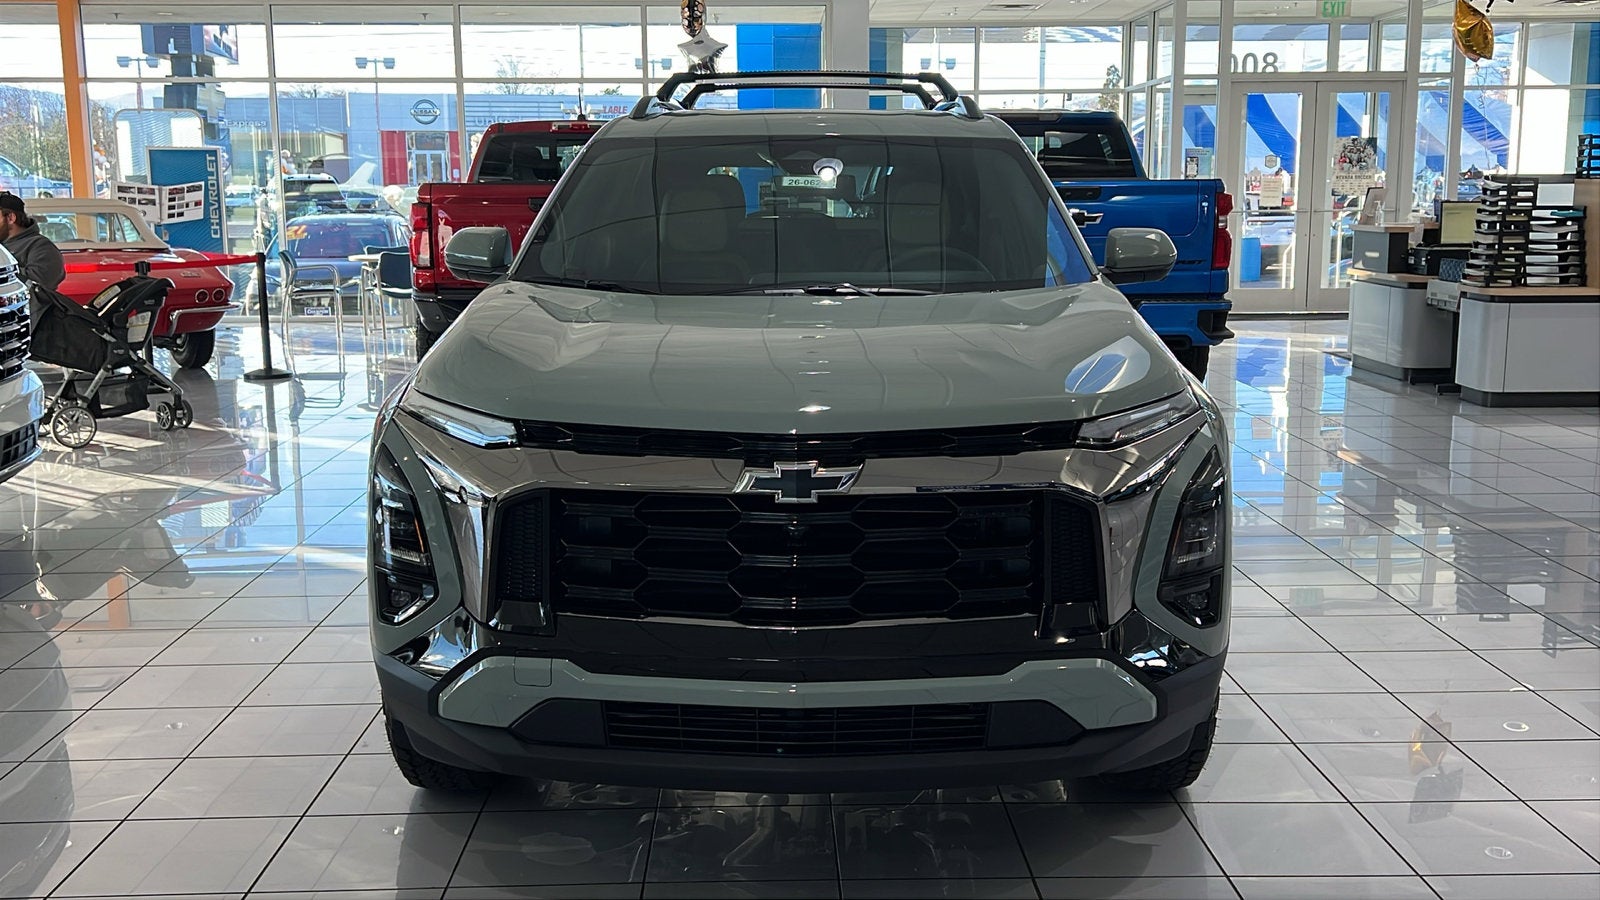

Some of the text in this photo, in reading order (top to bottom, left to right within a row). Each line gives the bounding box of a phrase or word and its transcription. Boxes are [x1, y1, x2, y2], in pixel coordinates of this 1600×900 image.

[1322, 1, 1346, 17] EXIT
[226, 120, 267, 128] Express
[788, 178, 821, 187] 26-062
[206, 154, 220, 238] CHEVROLET
